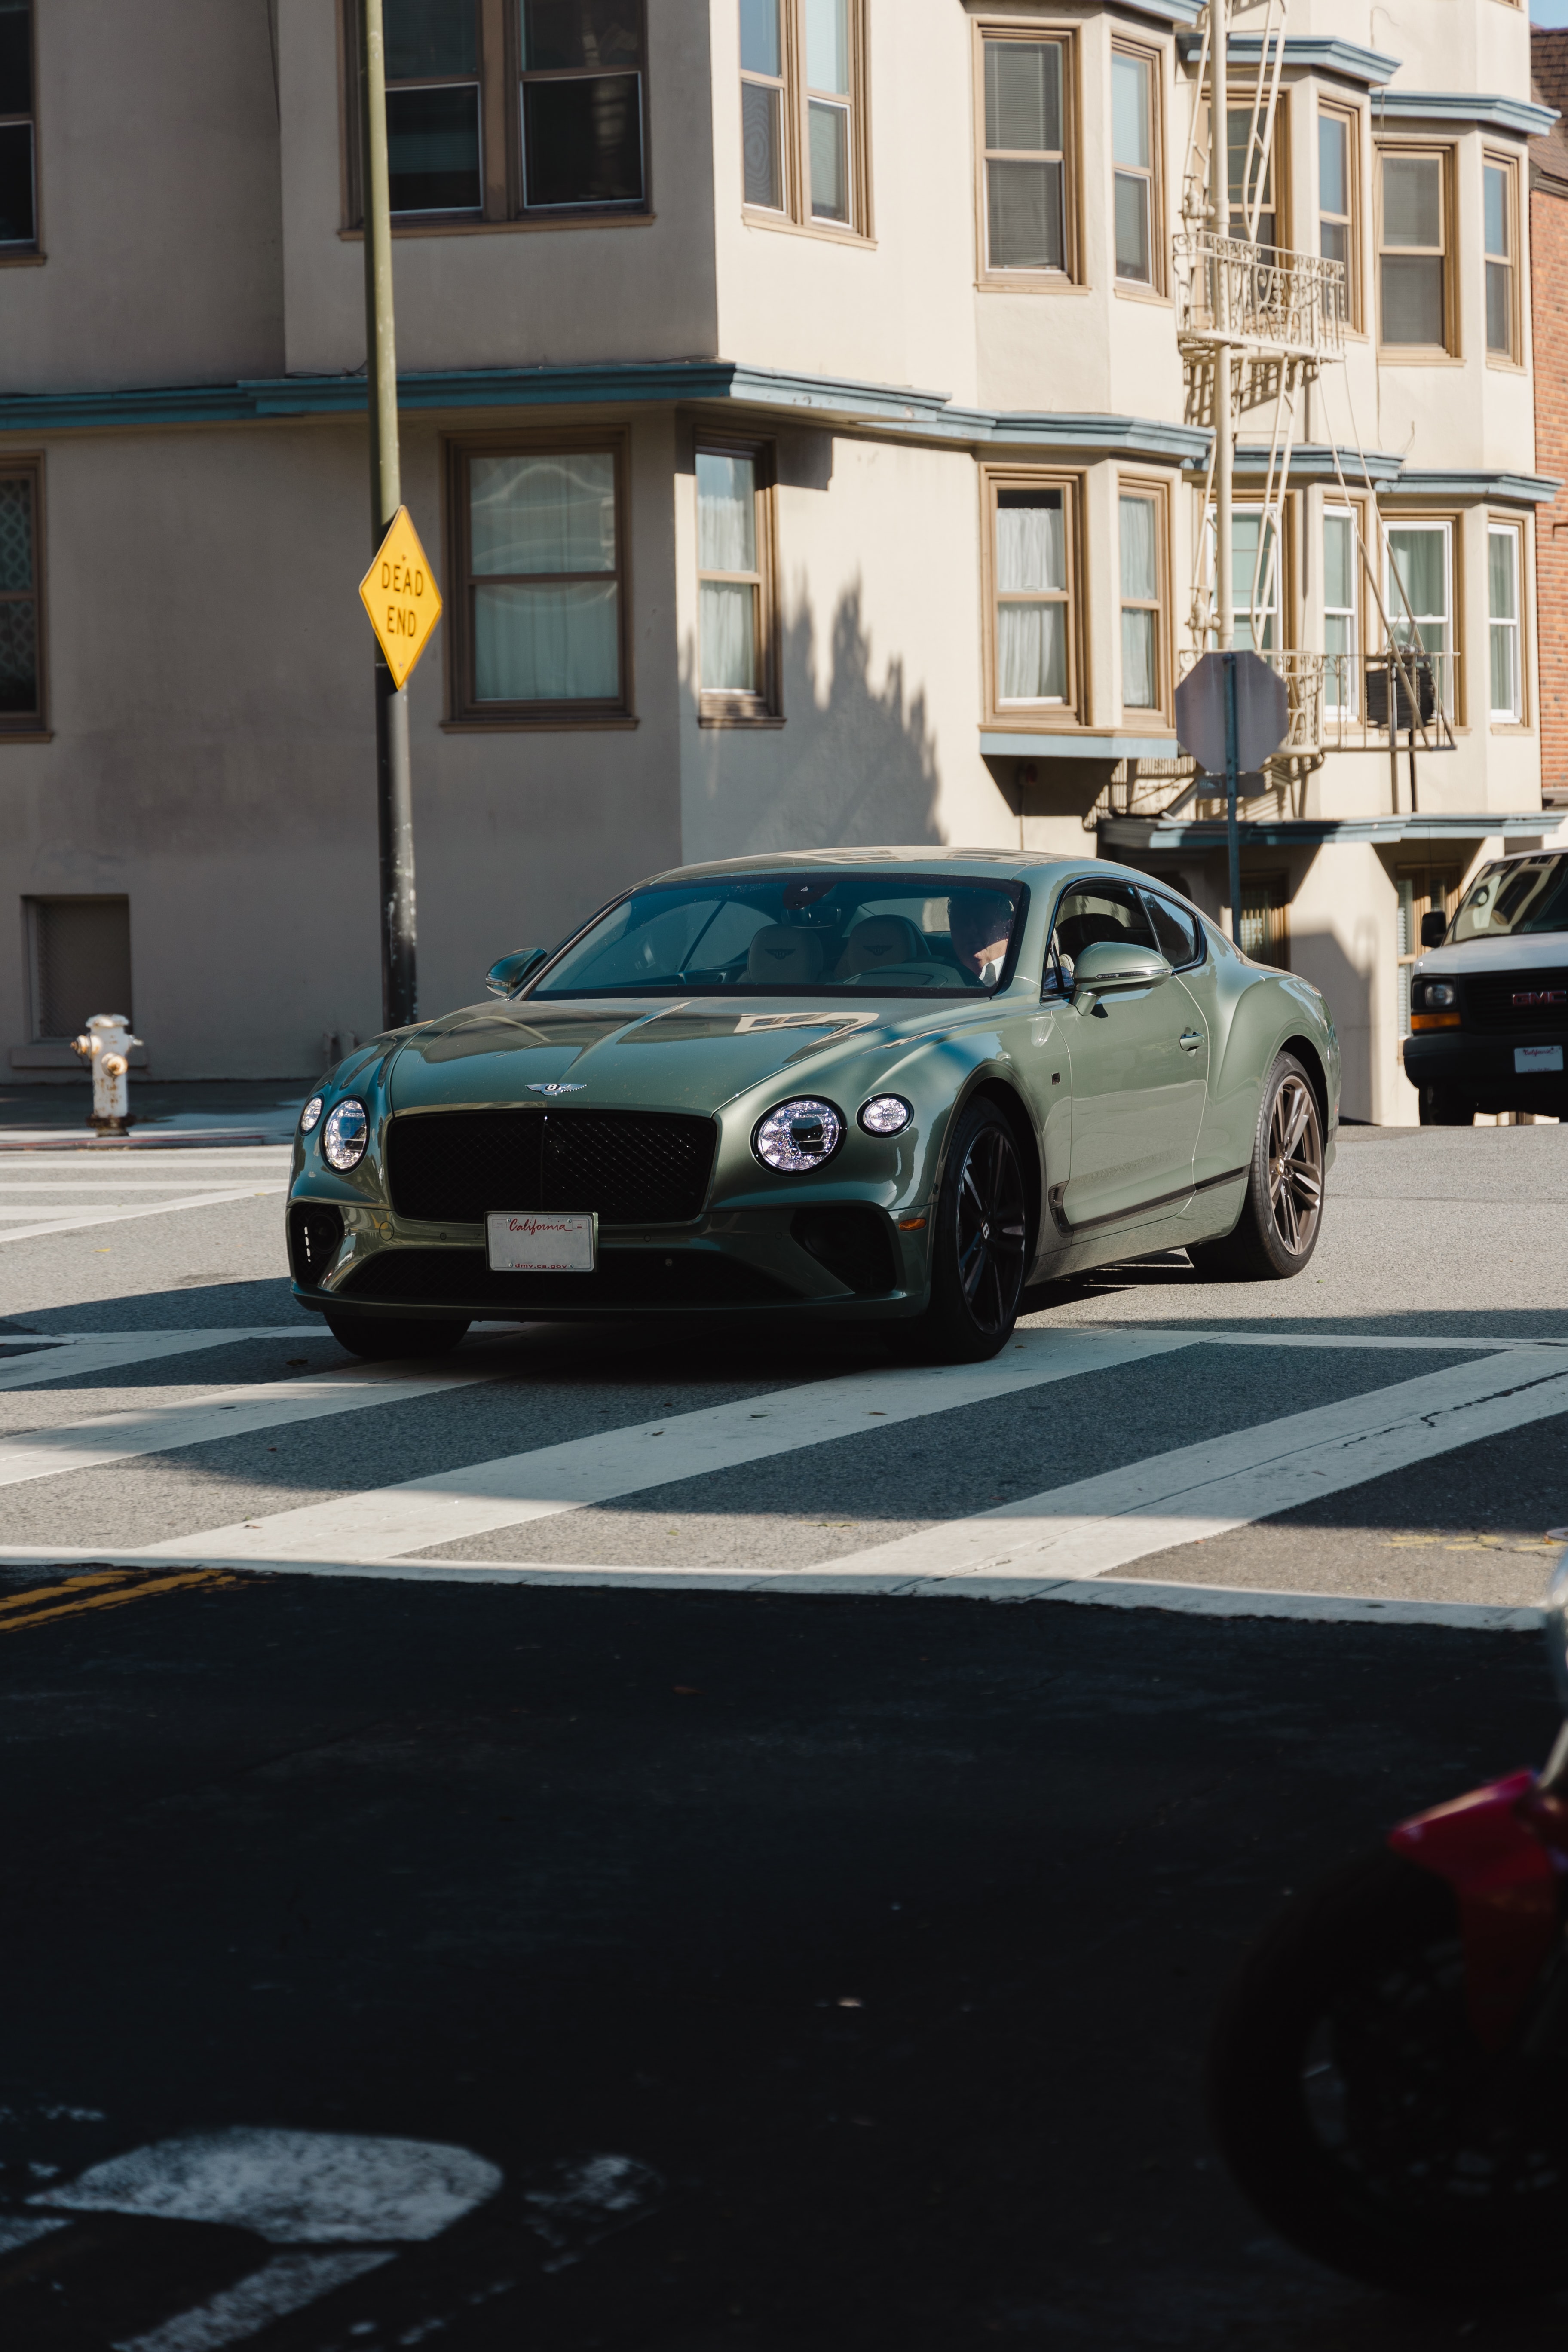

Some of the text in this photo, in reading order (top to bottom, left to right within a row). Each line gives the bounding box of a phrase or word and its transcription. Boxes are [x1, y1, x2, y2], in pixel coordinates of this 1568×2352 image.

[382, 561, 423, 597] DEAD
[387, 605, 416, 637] END
[1512, 990, 1567, 1005] GMC
[509, 1219, 573, 1235] California
